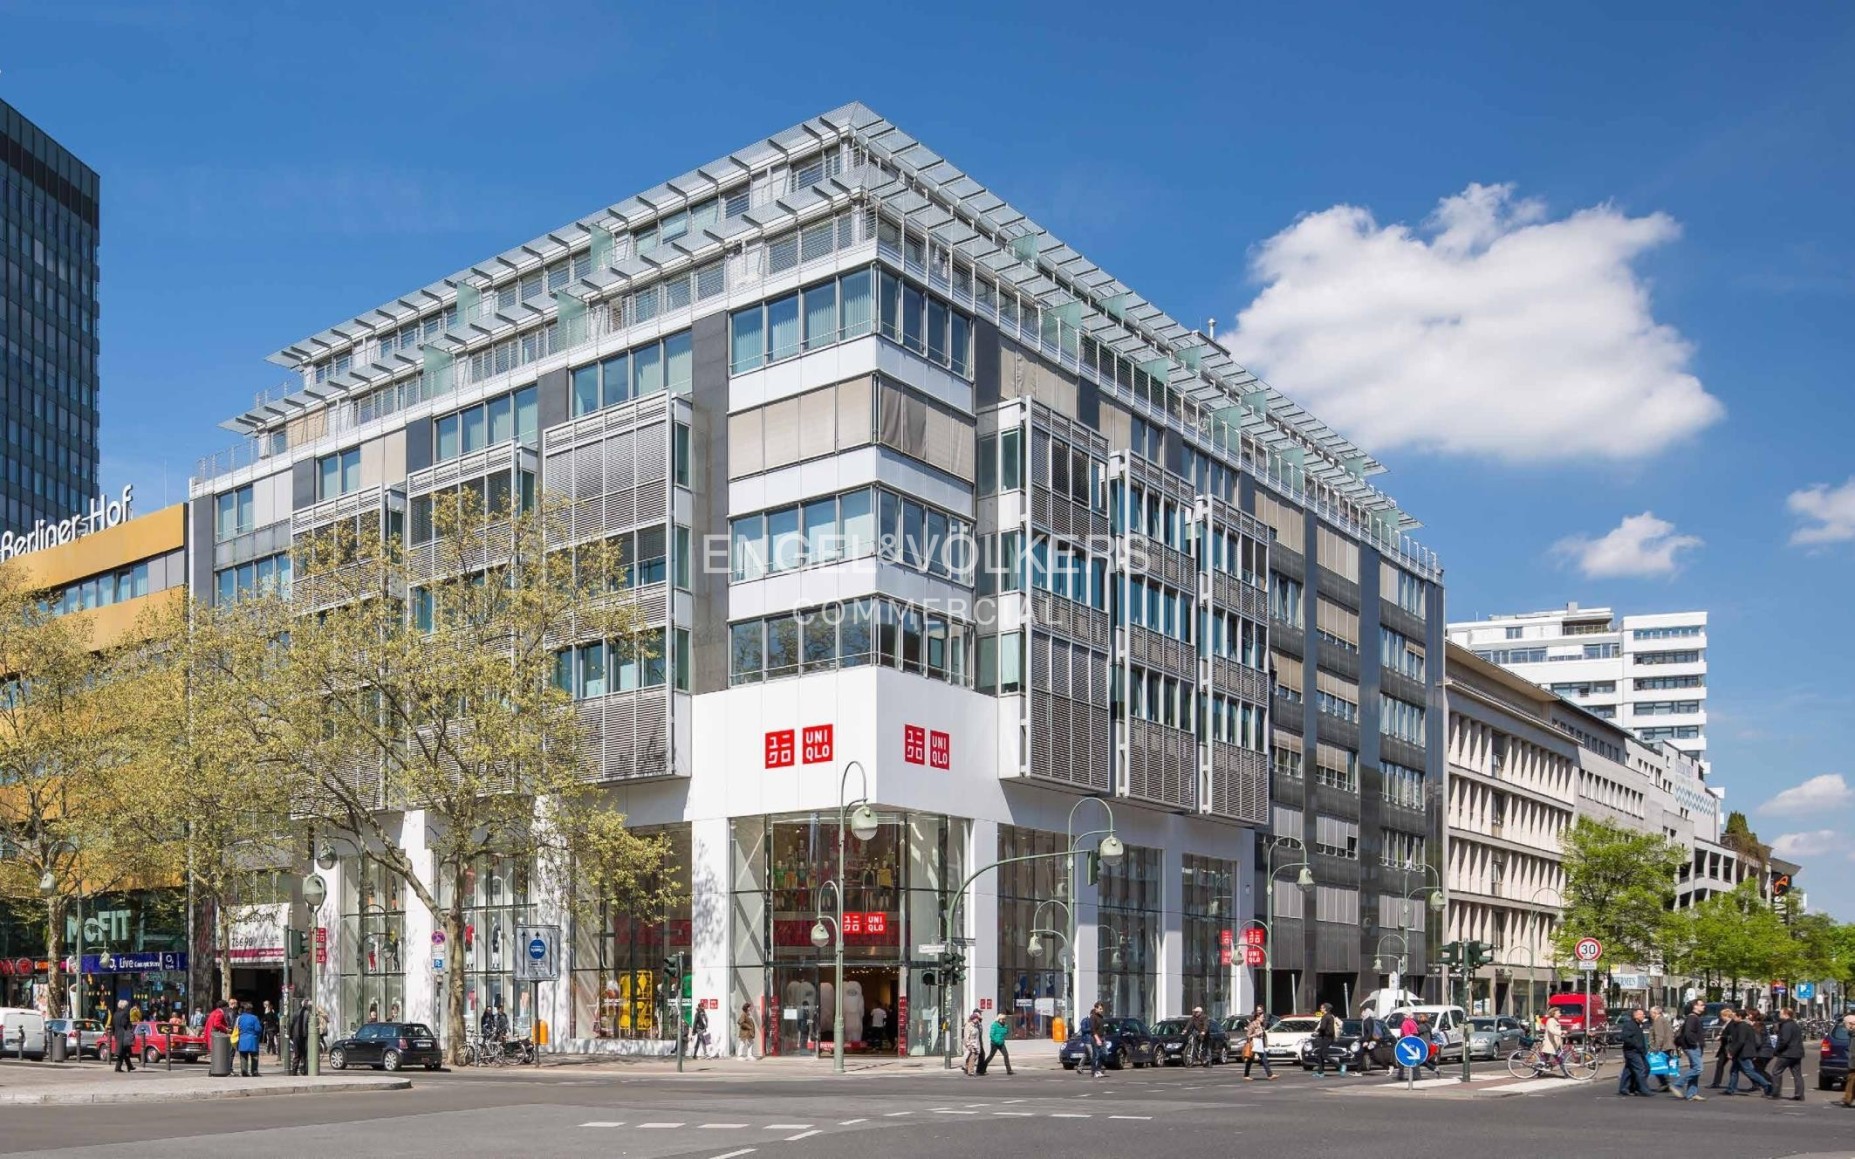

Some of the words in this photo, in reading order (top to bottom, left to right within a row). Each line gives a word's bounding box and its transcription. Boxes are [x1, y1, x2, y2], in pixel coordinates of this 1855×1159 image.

[805, 729, 829, 744] UNI
[931, 735, 947, 749] UNI
[805, 746, 830, 762] QLO
[931, 750, 948, 765] QLO
[867, 924, 884, 932] QLO
[1581, 944, 1596, 955] 30
[119, 957, 134, 968] Live
